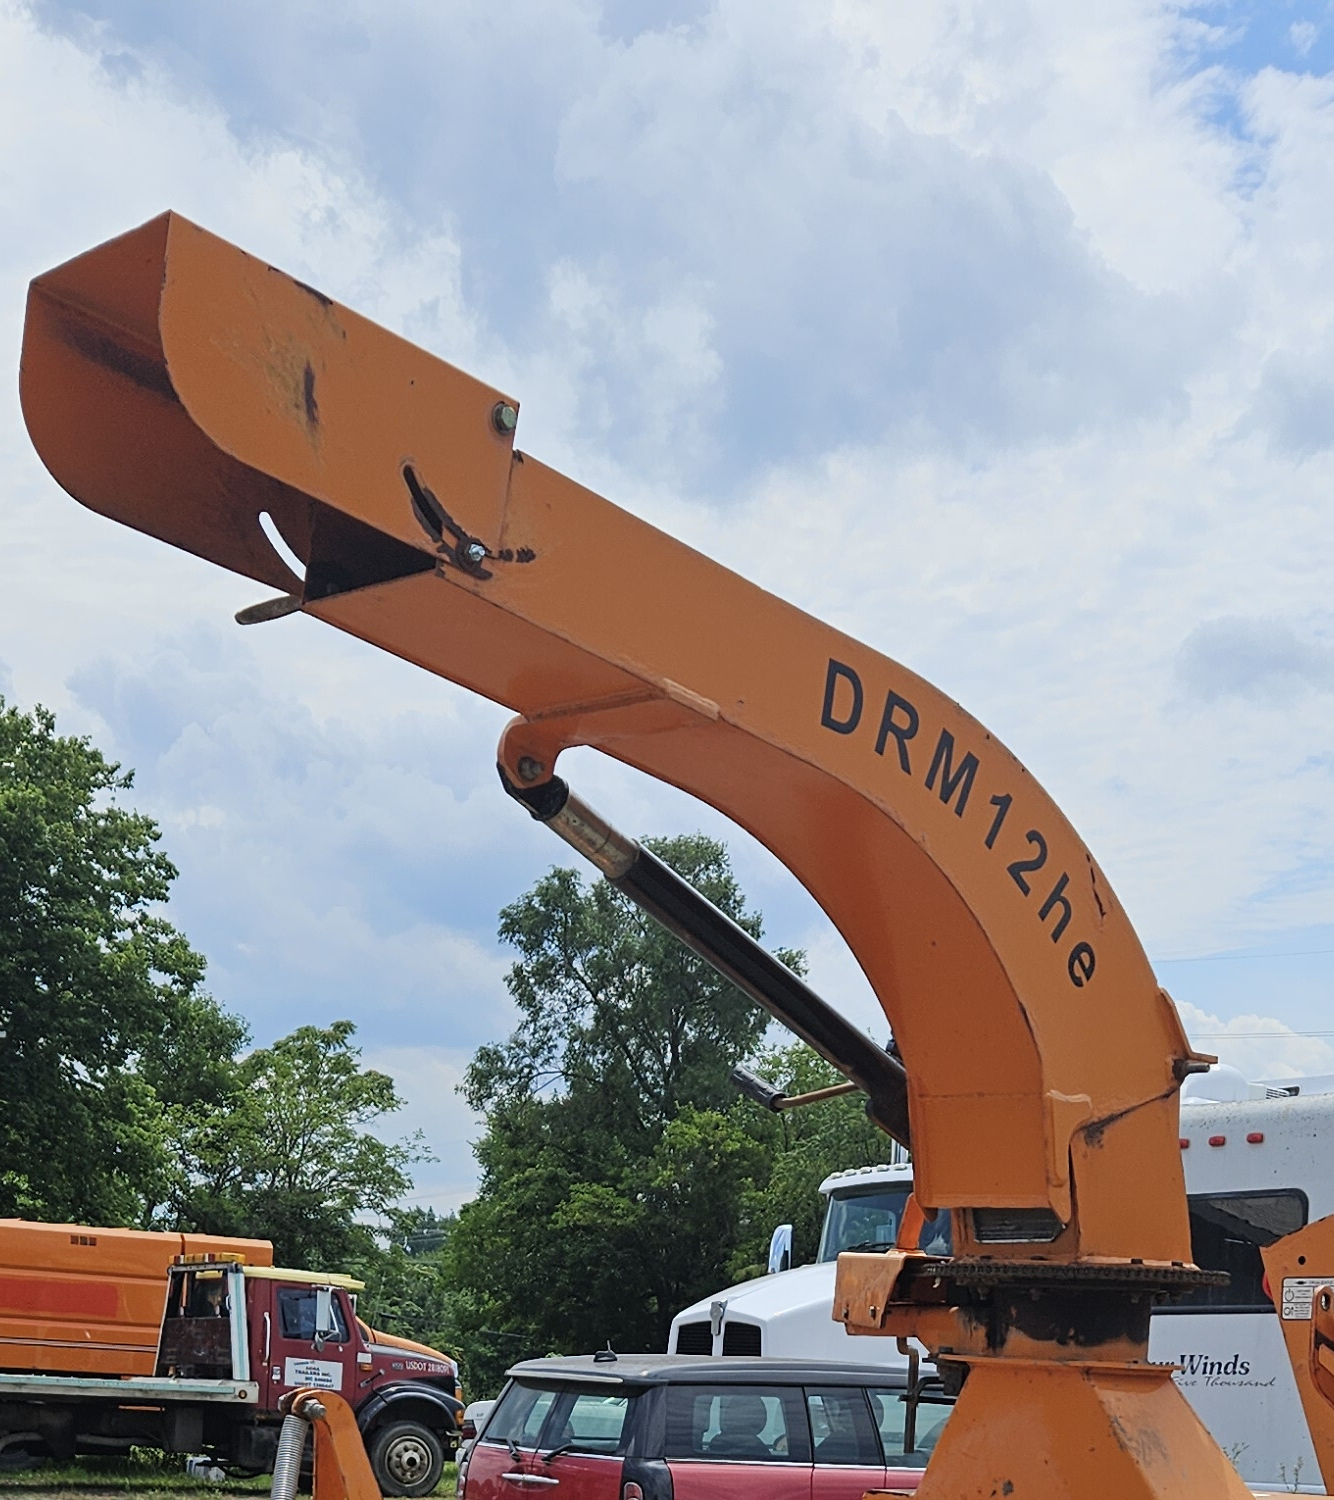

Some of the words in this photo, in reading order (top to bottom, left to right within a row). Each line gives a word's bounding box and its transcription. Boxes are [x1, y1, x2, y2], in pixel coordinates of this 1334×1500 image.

[821, 657, 1096, 988] DRM12he
[406, 1361, 426, 1371] USDOT
[1179, 1353, 1251, 1376] Winds
[1204, 1376, 1277, 1387] Thousand
